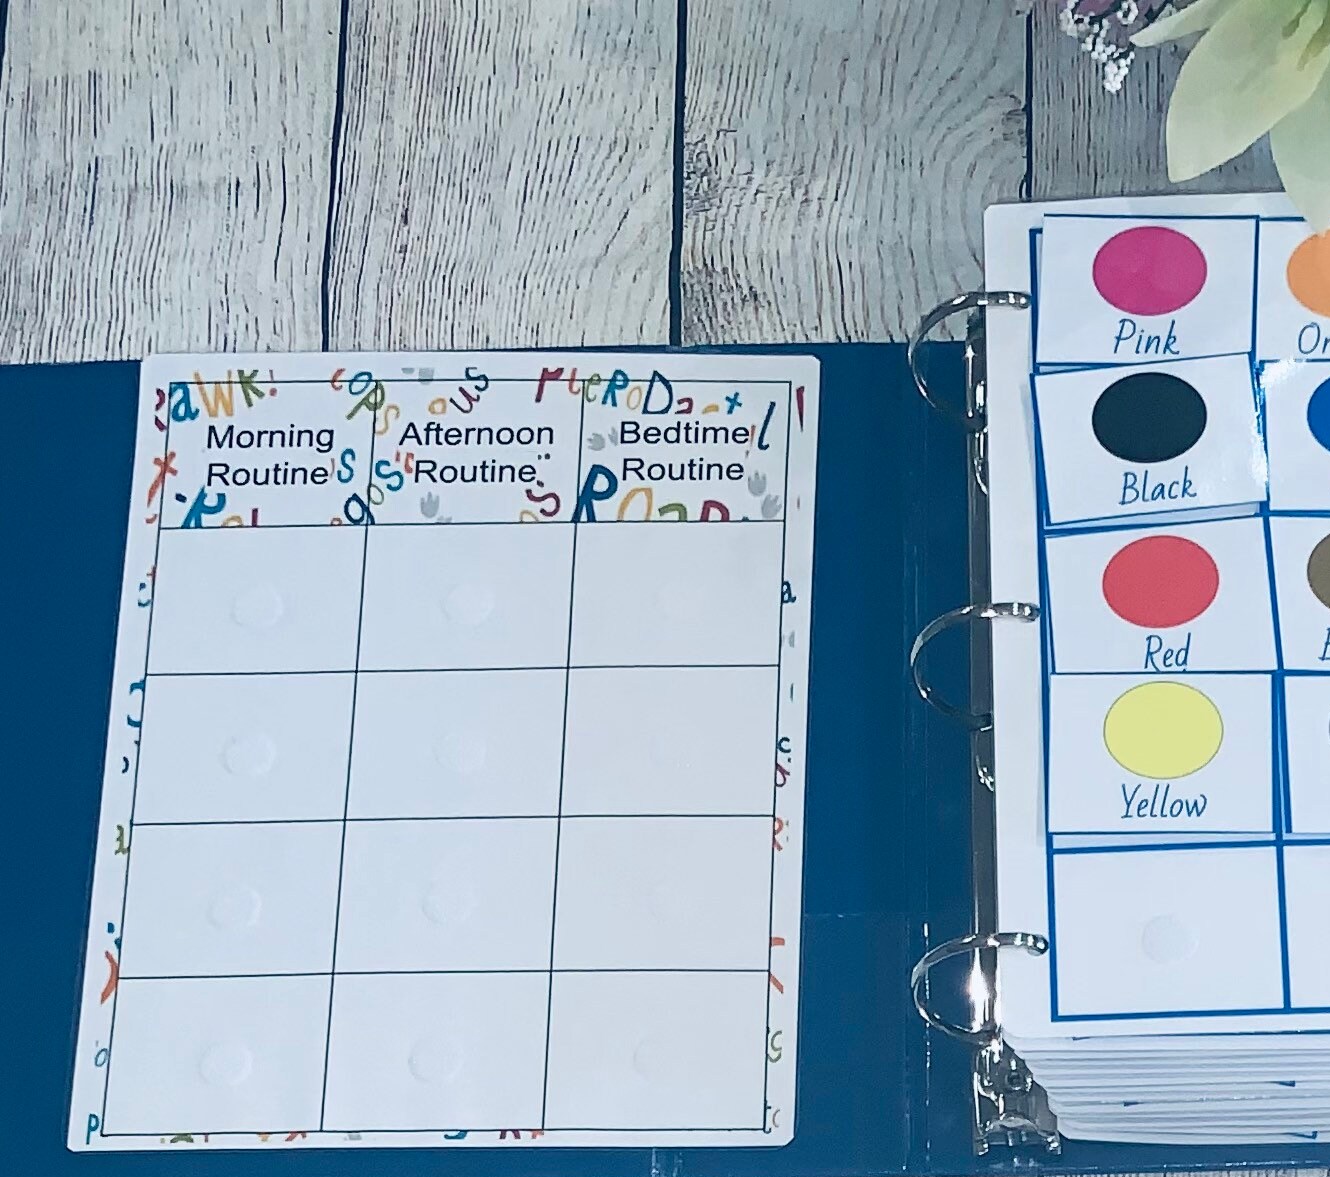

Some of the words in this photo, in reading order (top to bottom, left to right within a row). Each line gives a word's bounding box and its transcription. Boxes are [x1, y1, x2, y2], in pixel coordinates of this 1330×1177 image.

[1114, 318, 1181, 356] Pink
[206, 423, 335, 453] Morning
[398, 420, 554, 446] Afternoon
[619, 420, 751, 445] Bedtime
[206, 461, 329, 486] Routine
[414, 459, 537, 484] Routine
[622, 457, 744, 482] Routine
[1118, 470, 1198, 505] Black
[1143, 634, 1190, 671] Red
[1121, 783, 1208, 819] Yellow
